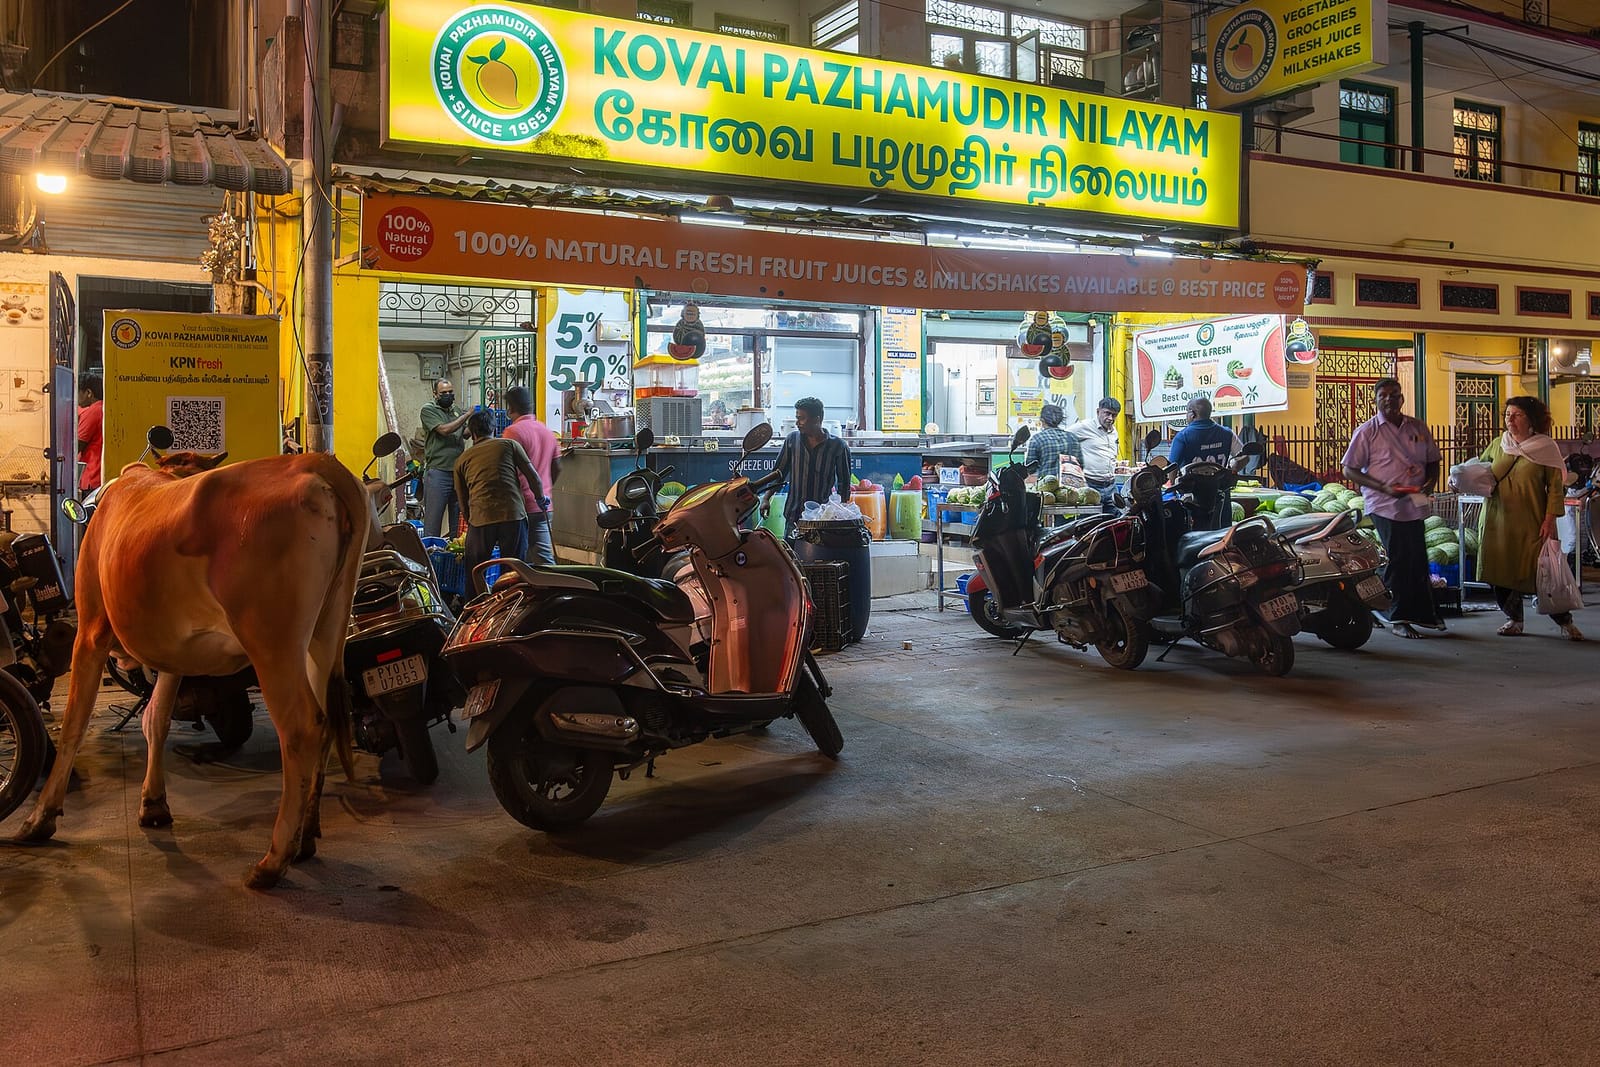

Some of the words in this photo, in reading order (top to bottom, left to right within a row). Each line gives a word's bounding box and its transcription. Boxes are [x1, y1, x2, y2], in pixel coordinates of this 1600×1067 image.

[1287, 7, 1357, 40] GROCERIES
[1283, 37, 1322, 59] FRESH
[1326, 24, 1362, 46] JUICE
[440, 49, 454, 90] KOVAI
[449, 15, 538, 43] PAZHAMUDIR
[538, 44, 559, 108] NILAYAM
[1283, 42, 1362, 76] MILKSHAKES
[594, 27, 745, 94] KOVAI
[764, 53, 1048, 137] PAZHAMUDIR
[1059, 100, 1209, 158] NILAYAM
[1221, 76, 1246, 91] SINCE
[451, 100, 504, 138] SINCE
[508, 110, 548, 138] 1965
[594, 89, 813, 163] கோவை
[833, 132, 1018, 196] பழமுதிர்
[1028, 144, 1207, 207] நிலையம்
[384, 213, 430, 233] 100%
[385, 231, 428, 244] Natural
[389, 244, 422, 256] Fruits
[454, 230, 538, 259] 100%
[545, 238, 669, 269] NATURAL
[675, 249, 754, 276] FRESH
[759, 256, 829, 281] FRUIT
[832, 263, 907, 288] JUICES
[912, 269, 928, 289] &
[933, 271, 1060, 294] MILKSHAKES
[1064, 275, 1158, 297] AVAILABLE
[1161, 278, 1175, 296] @
[1178, 280, 1219, 298] BEST
[1222, 281, 1266, 299] PRICE
[145, 332, 172, 340] KOVAI
[174, 332, 229, 342] PAZHAMUDIR
[231, 334, 268, 343] NILAYAM
[584, 342, 598, 353] to
[1178, 350, 1201, 361] SWEET
[1202, 349, 1208, 358] &
[1209, 345, 1232, 357] FRESH
[549, 354, 627, 391] 50%
[1162, 392, 1179, 403] Best
[1181, 389, 1212, 402] Quality
[728, 459, 762, 471] SQUEEZE
[378, 659, 415, 679] PY01C
[381, 671, 418, 690] U7853
